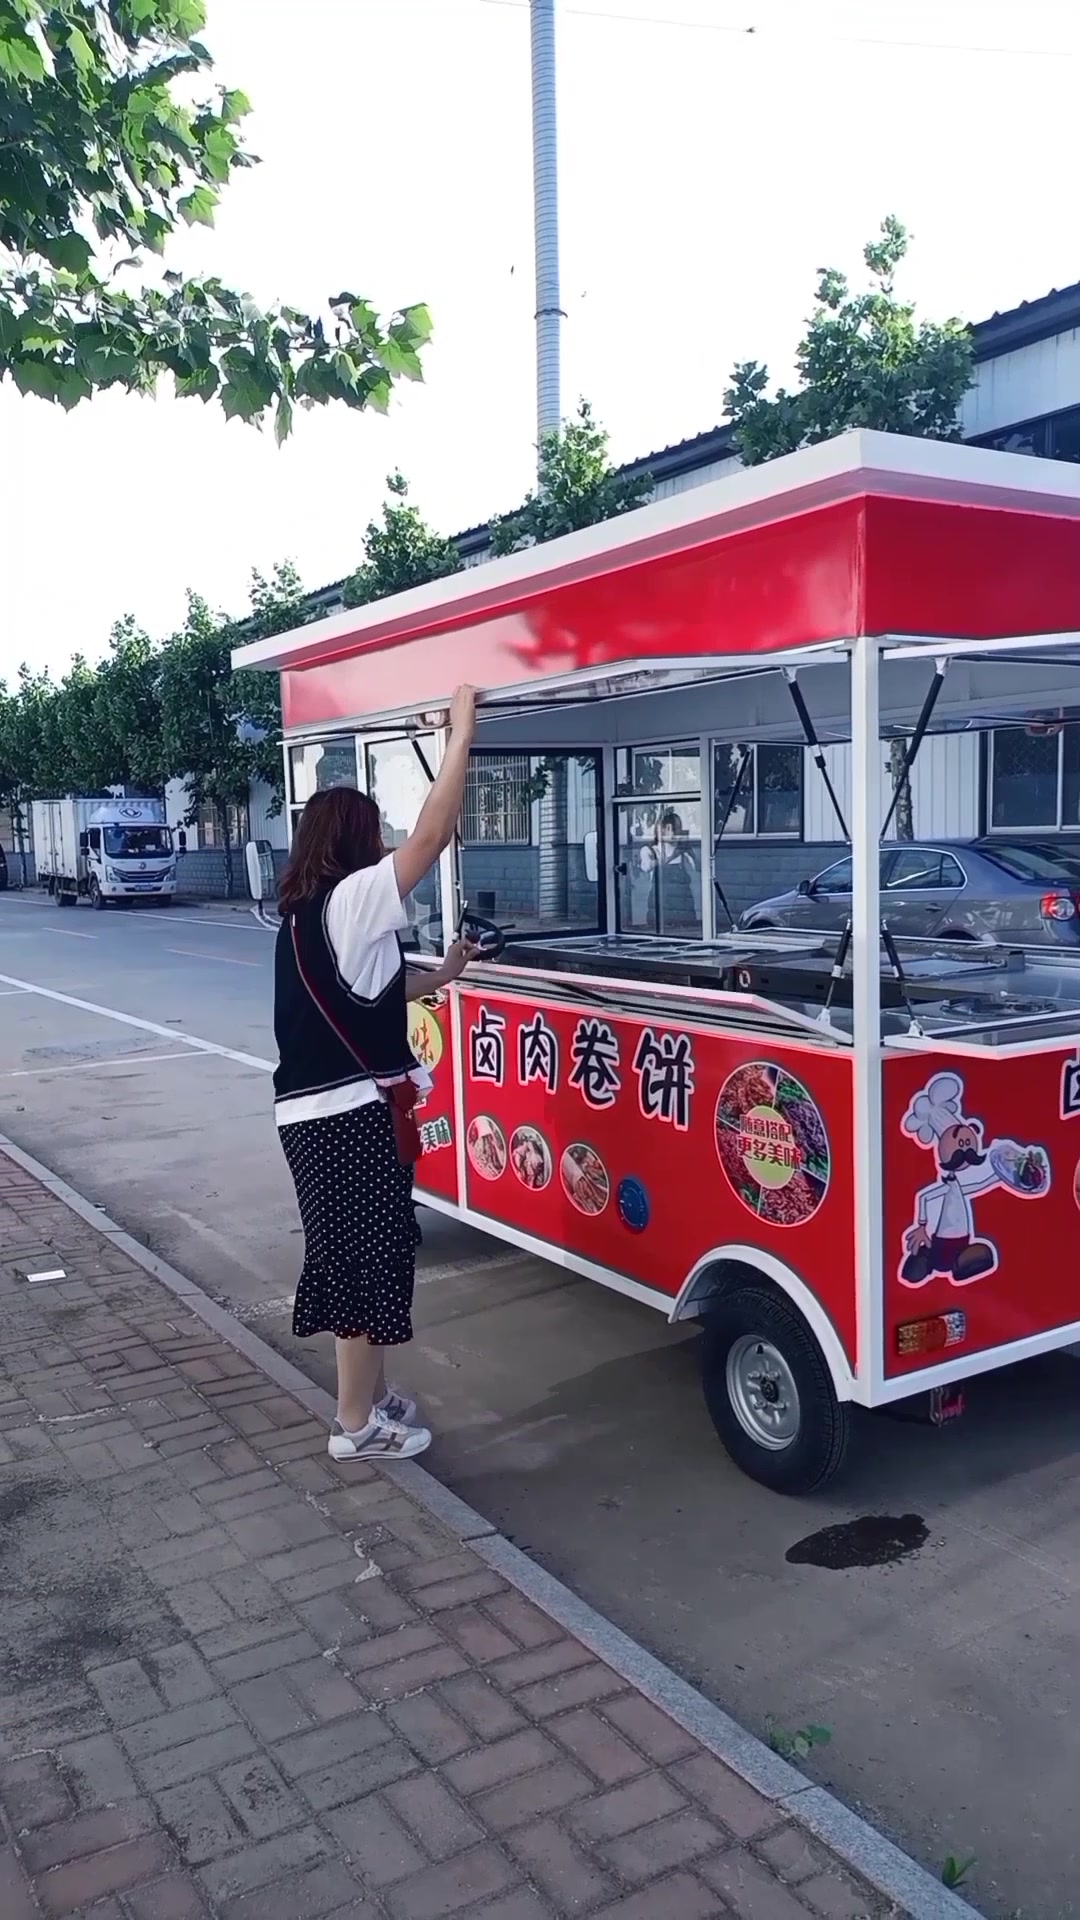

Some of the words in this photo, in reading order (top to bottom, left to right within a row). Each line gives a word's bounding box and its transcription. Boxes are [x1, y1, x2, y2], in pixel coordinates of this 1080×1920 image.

[468, 1006, 694, 1130] 卤肉卷饼
[739, 1115, 792, 1143] 随意搭配
[737, 1135, 802, 1168] 更多美味
